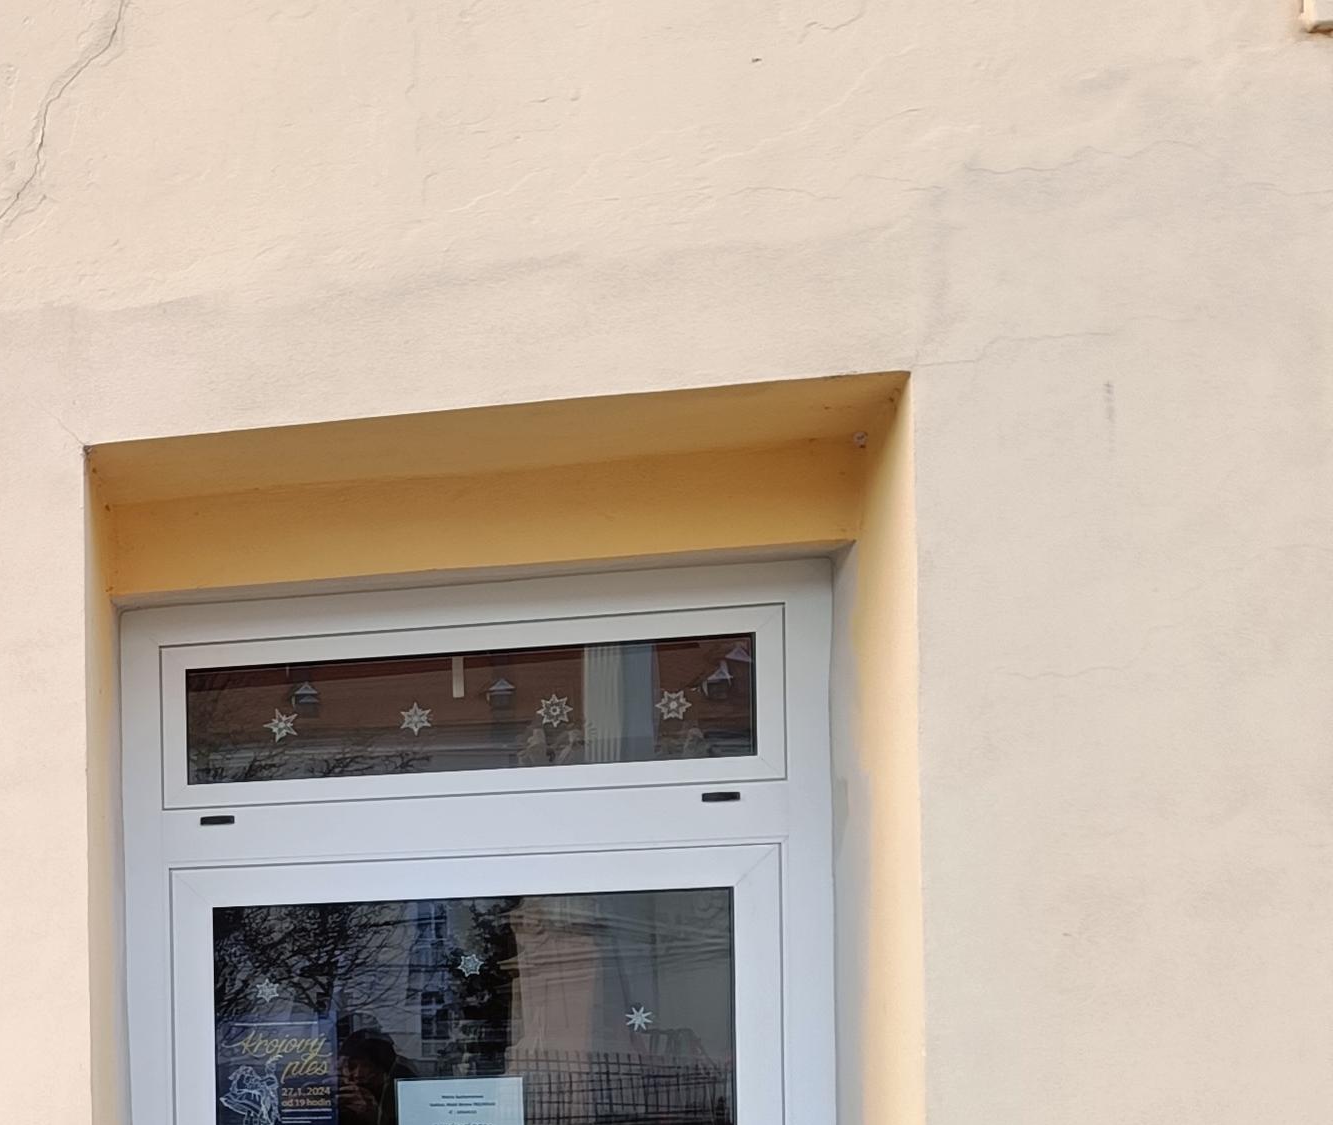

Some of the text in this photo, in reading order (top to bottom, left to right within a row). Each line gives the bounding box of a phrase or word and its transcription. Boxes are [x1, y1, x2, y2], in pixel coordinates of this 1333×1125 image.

[281, 1056, 328, 1084] ples
[281, 1098, 332, 1108] od 19 hodin
